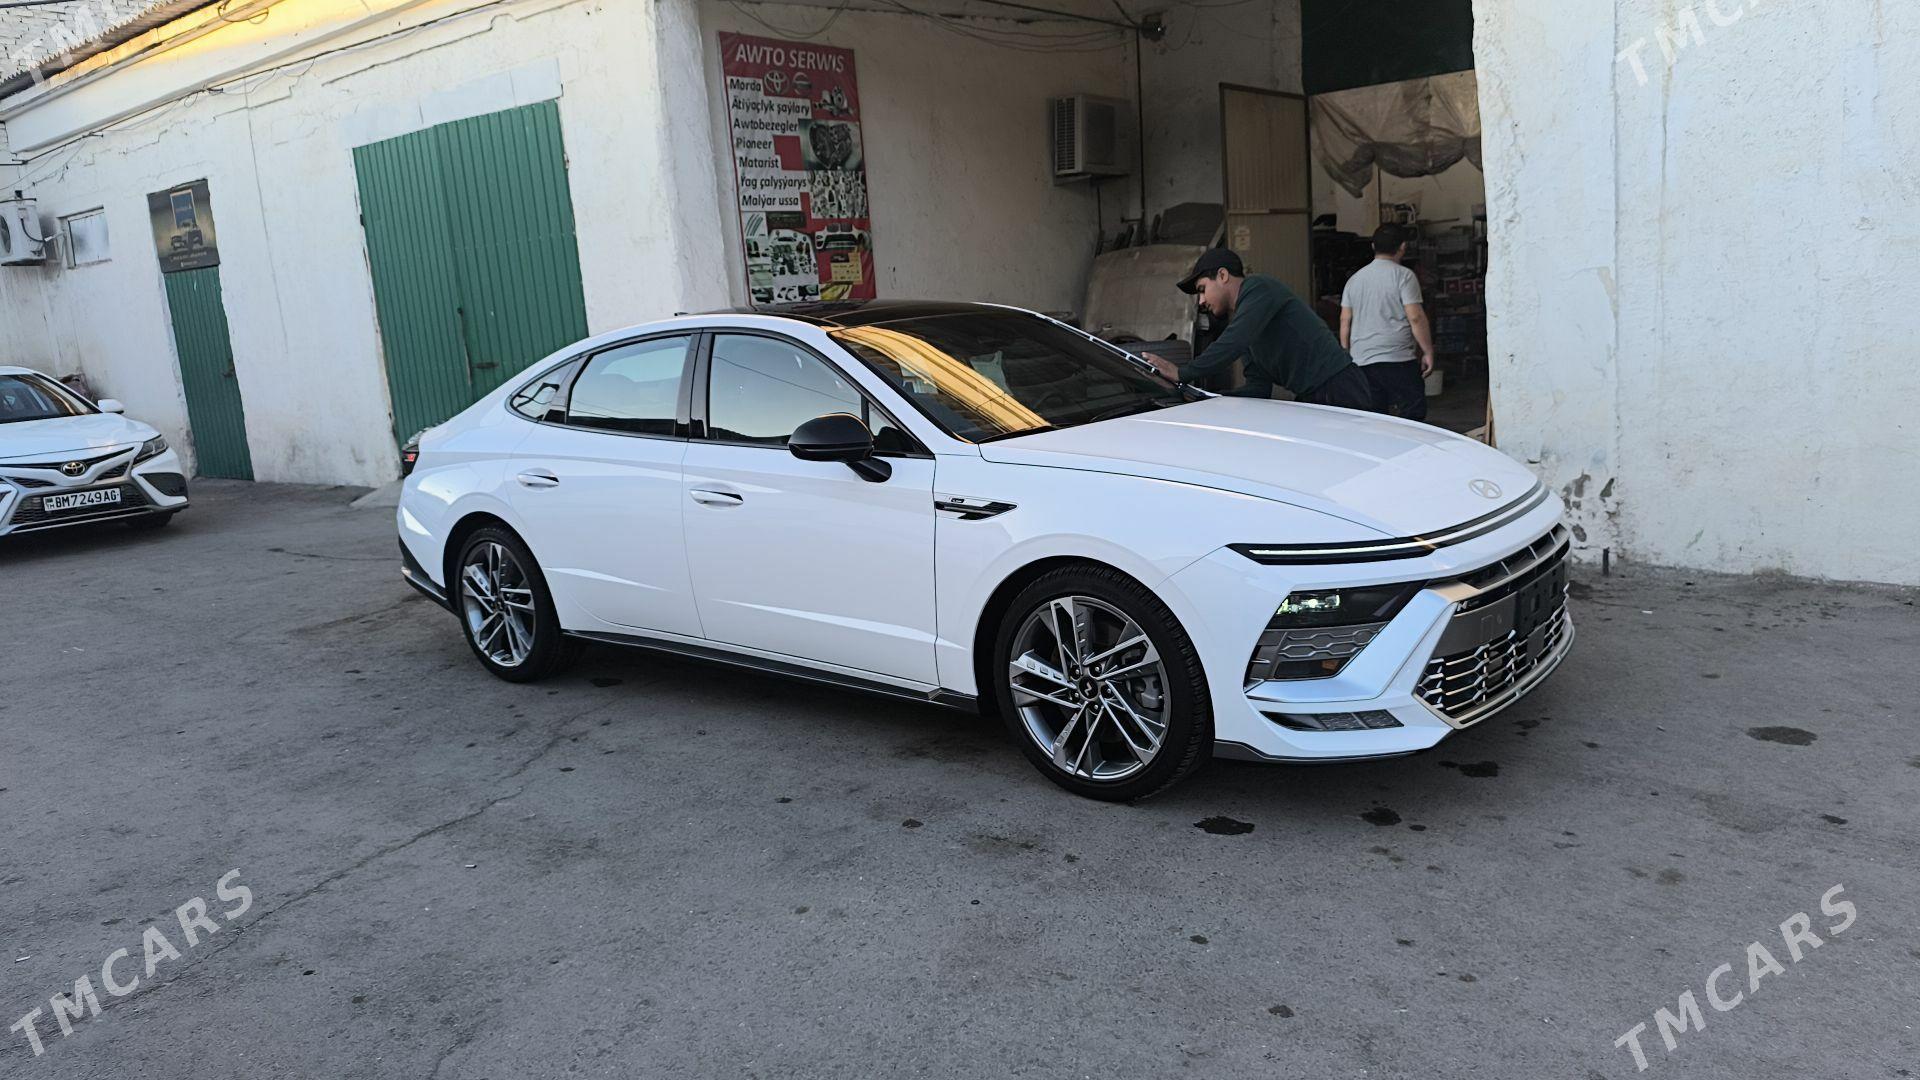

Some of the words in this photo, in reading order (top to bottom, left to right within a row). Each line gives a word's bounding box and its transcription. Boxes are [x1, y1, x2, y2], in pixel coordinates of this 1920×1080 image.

[735, 43, 785, 67] AWTO
[789, 49, 844, 73] SERWIS
[729, 78, 762, 92] Morda
[735, 137, 773, 150] Pioneer
[778, 198, 799, 206] ussa
[55, 489, 117, 508] BM7249AG
